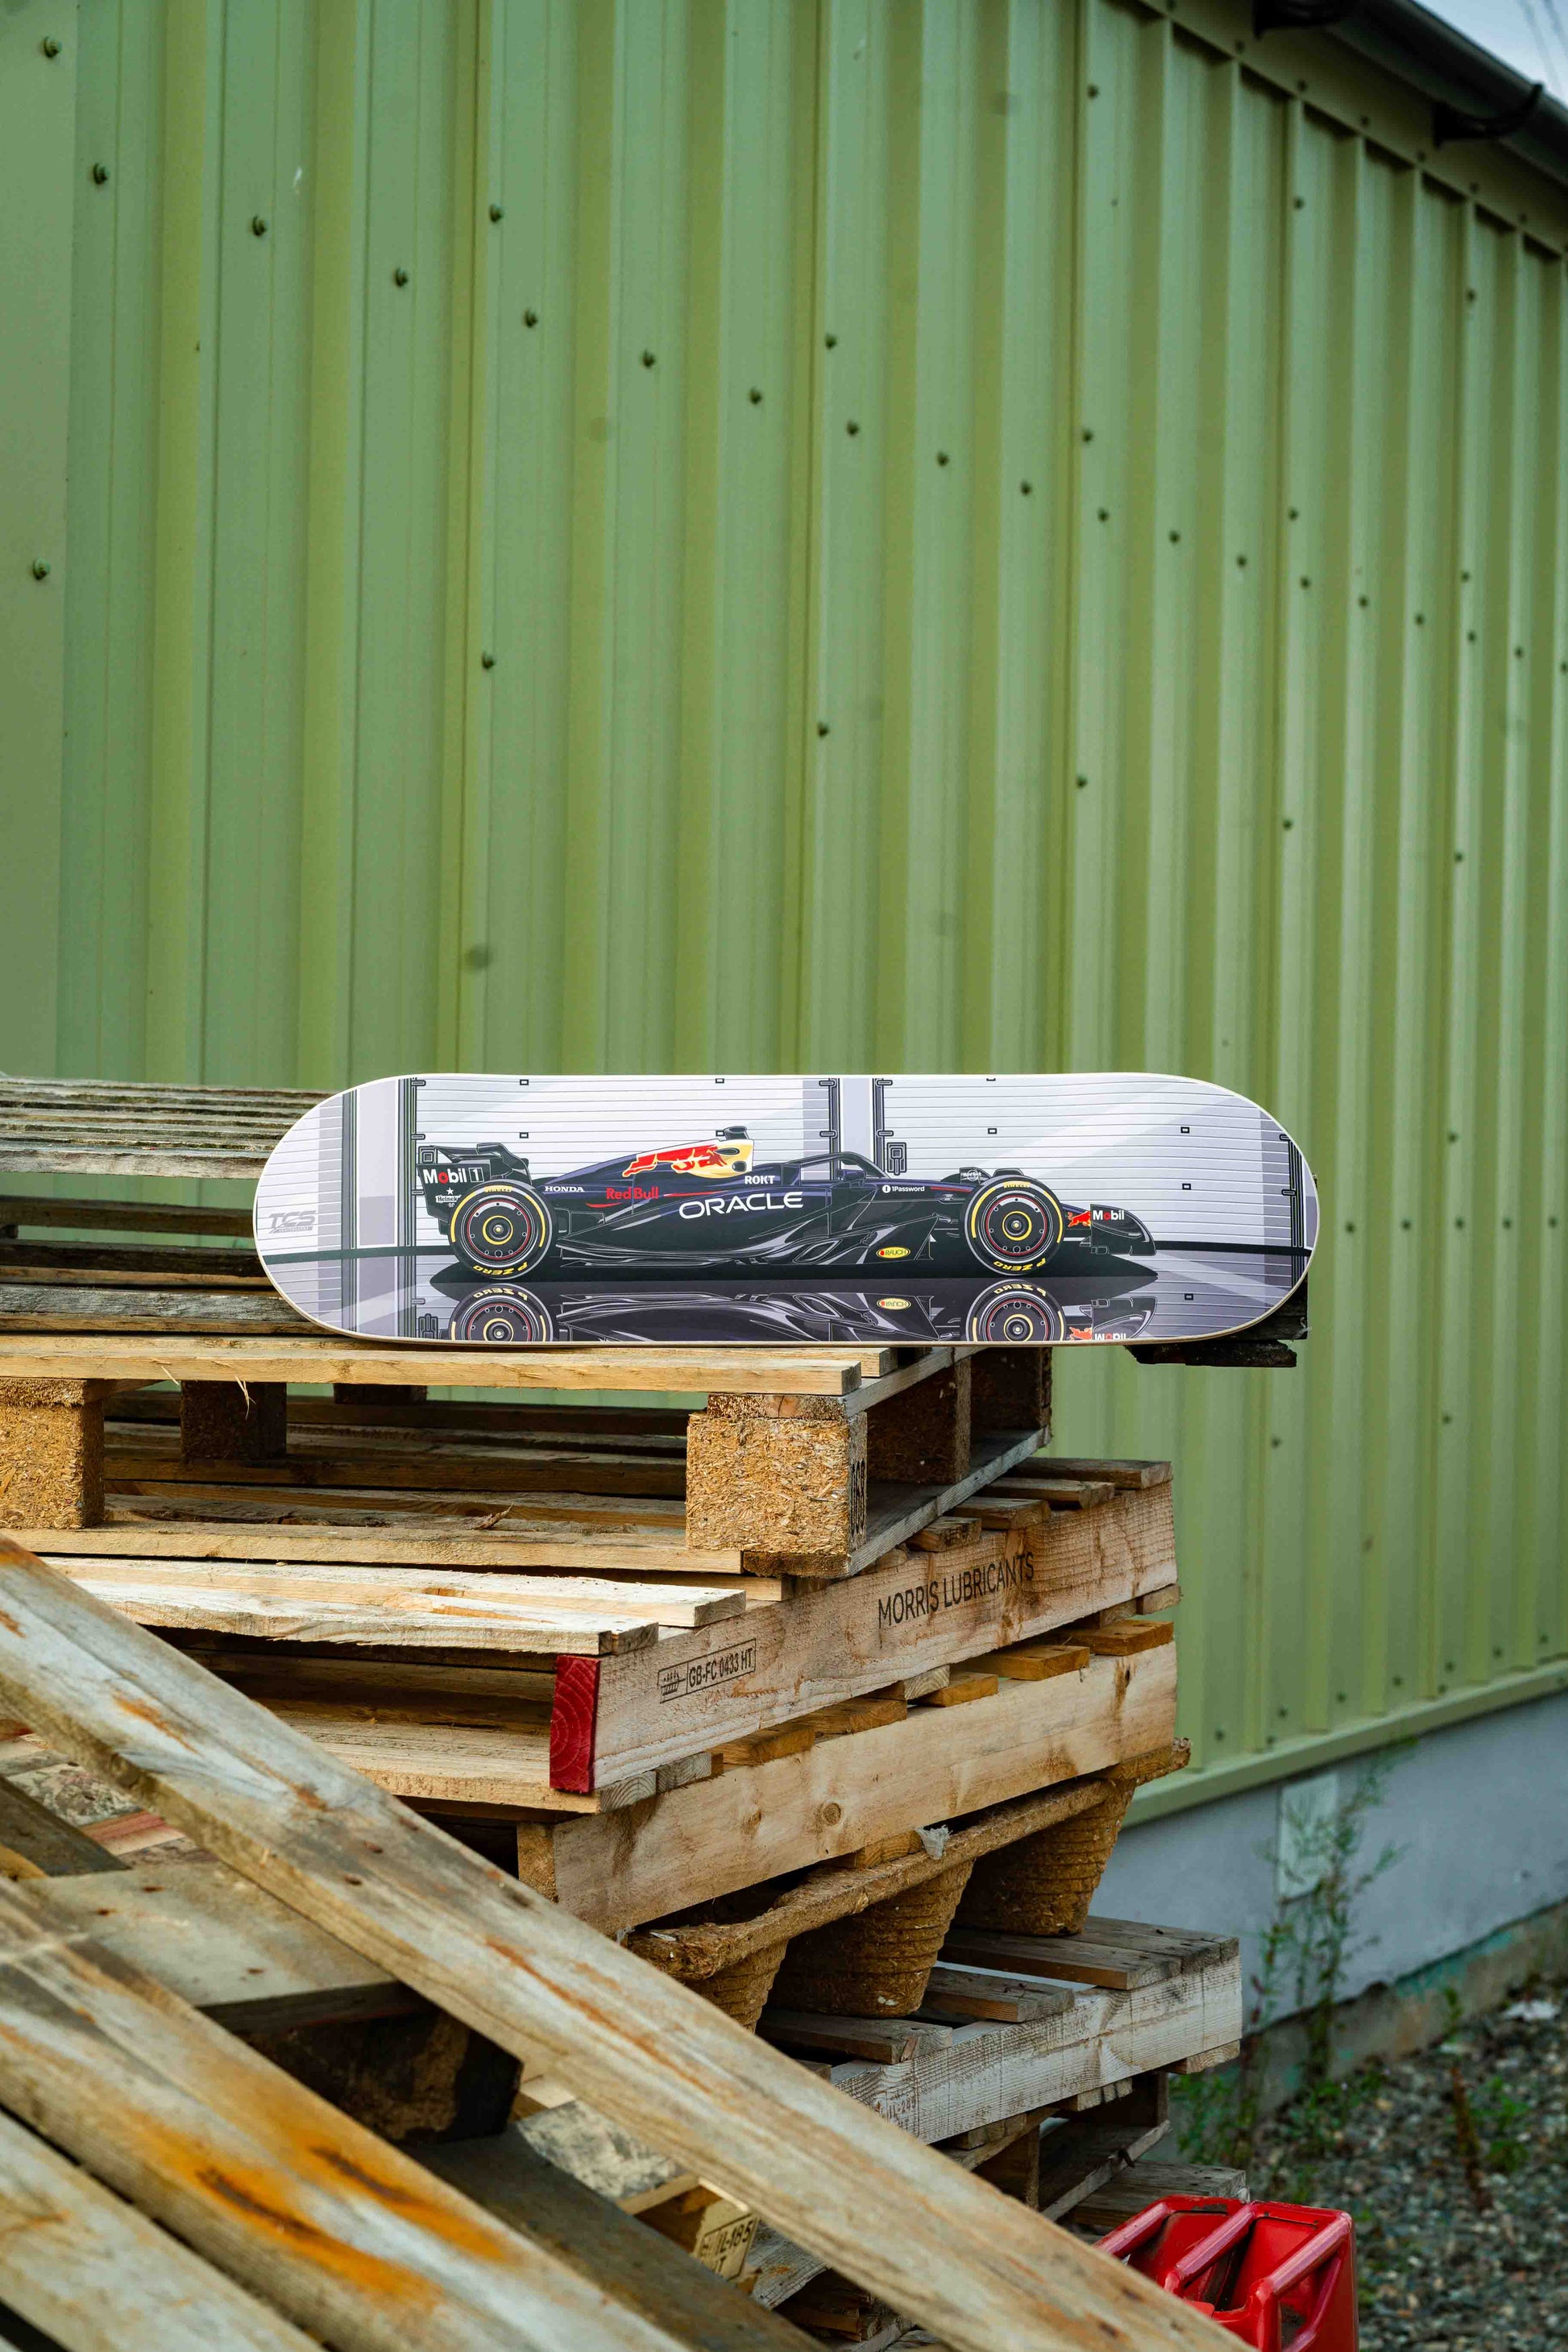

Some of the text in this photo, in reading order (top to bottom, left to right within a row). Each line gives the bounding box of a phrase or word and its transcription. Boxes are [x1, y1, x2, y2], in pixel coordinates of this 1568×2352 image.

[423, 1168, 467, 1184] Mobil
[745, 1175, 776, 1184] ROKT
[606, 1186, 659, 1200] Red Bull
[678, 1191, 804, 1220] ORACLE
[1093, 1209, 1125, 1221] Mobil
[472, 1261, 528, 1276] P ZERO
[993, 1257, 1046, 1271] P ZERO
[877, 1551, 1035, 1629] MORRIS LUBRICANTS
[689, 1647, 753, 1687] GB-FC 0433 HT
